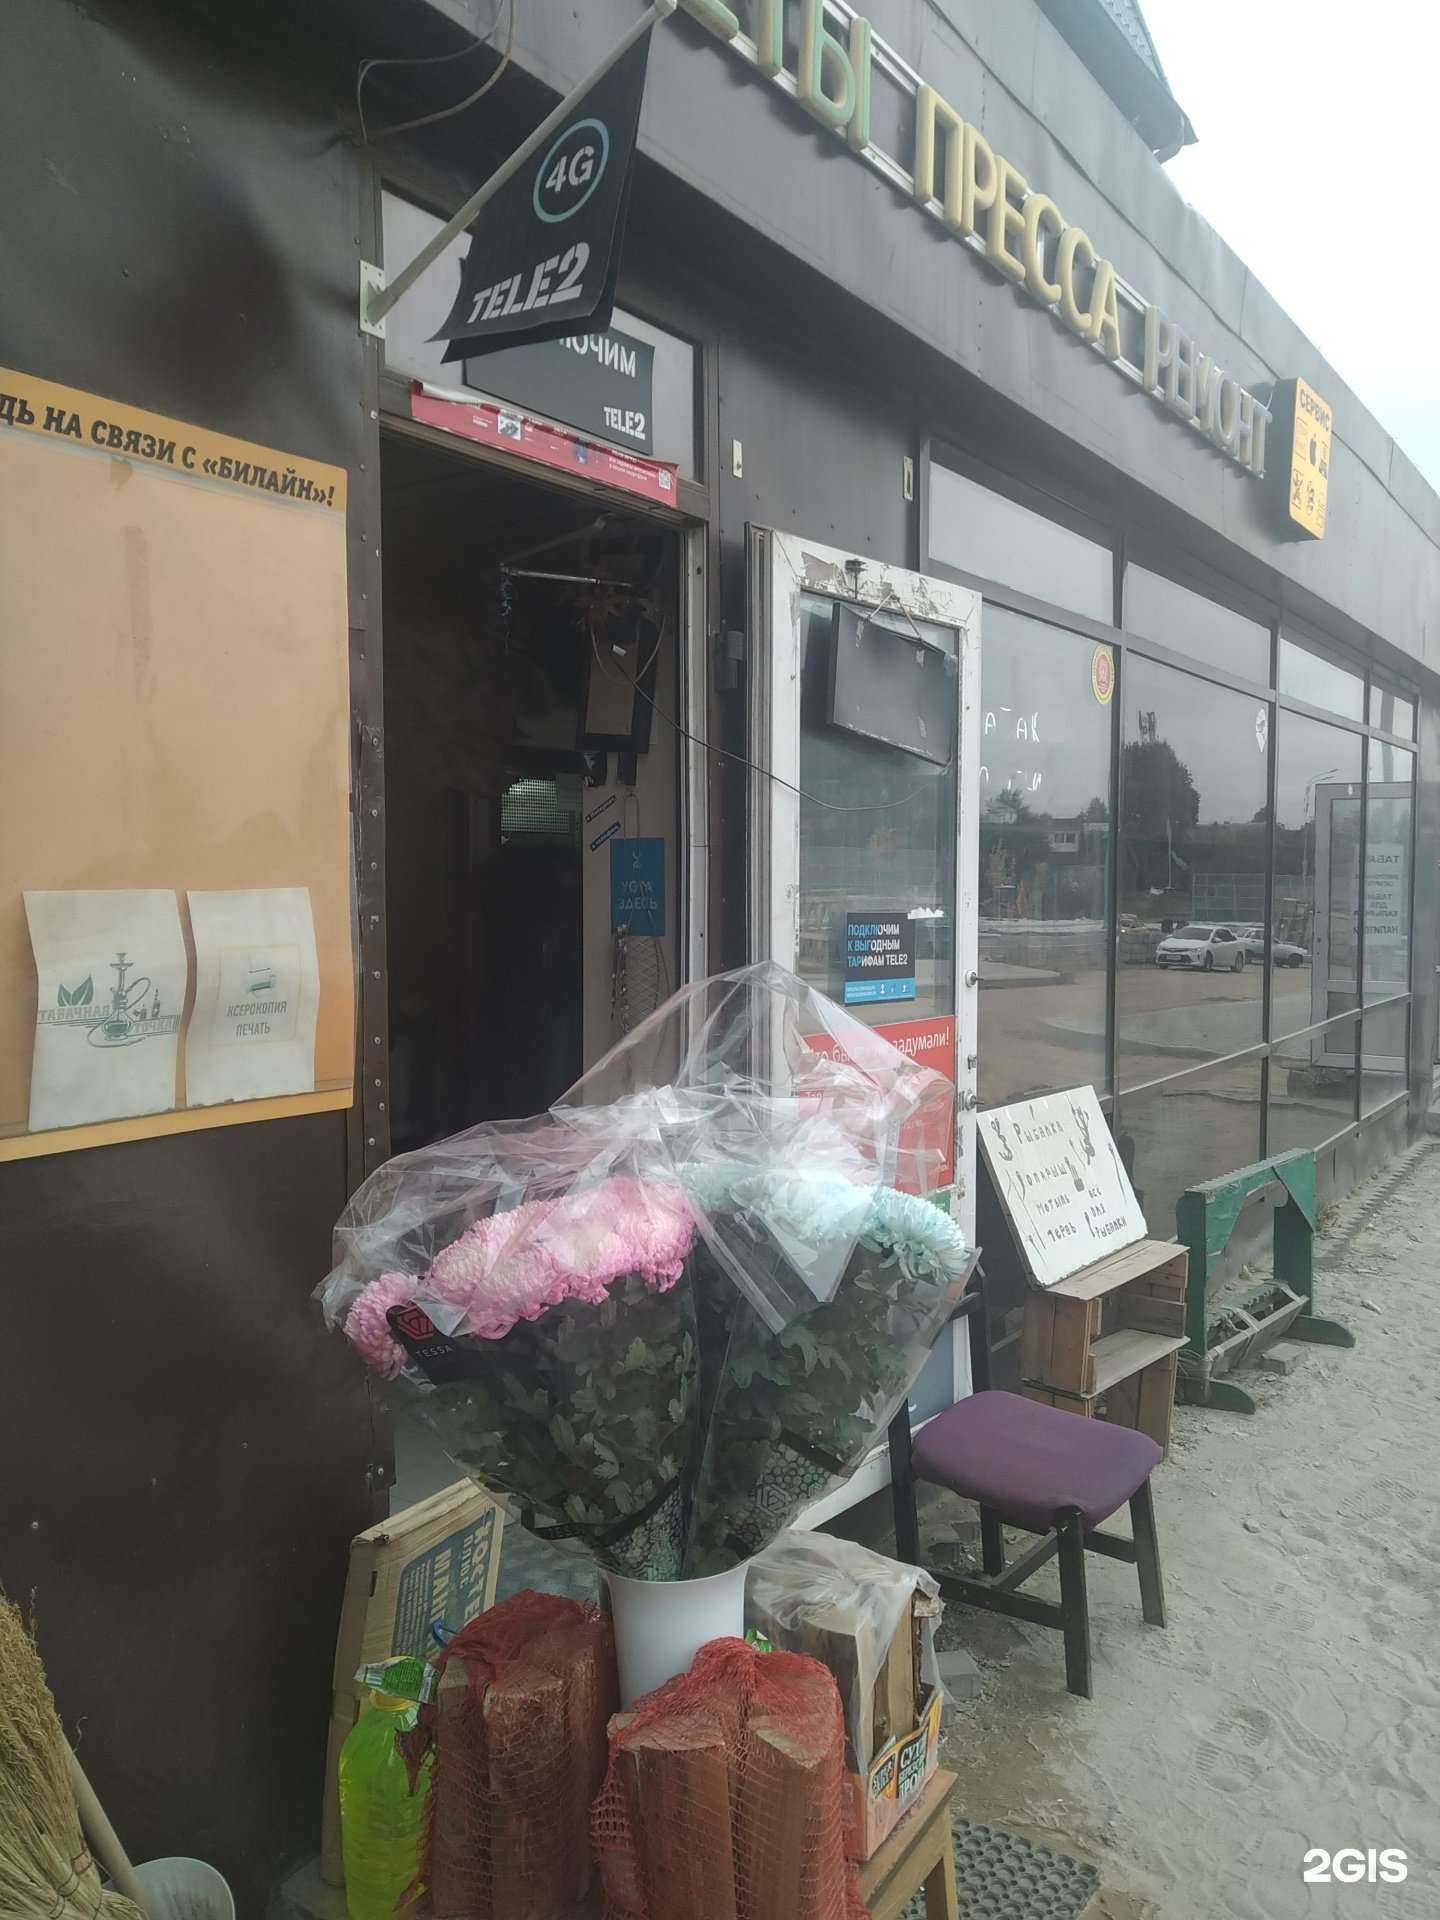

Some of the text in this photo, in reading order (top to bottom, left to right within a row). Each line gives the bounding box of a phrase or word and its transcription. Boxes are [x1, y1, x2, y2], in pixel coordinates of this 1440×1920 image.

[546, 145, 595, 193] 4G
[467, 241, 591, 324] TELE2
[914, 83, 1121, 359] ПРЕССА
[1142, 304, 1273, 476] РЕМОНТ
[604, 406, 646, 441] TELE2
[1300, 388, 1331, 434] СЕРВИС
[43, 405, 83, 439] НА
[91, 419, 177, 465] СВЯЗИ
[182, 446, 197, 470] С
[202, 455, 335, 507] «БИЛАЙН»!
[847, 923, 900, 938] ПОДКЛЮЧИМ
[854, 939, 901, 953] ВЫГОДНЫМ
[886, 953, 909, 966] TELE2
[226, 1000, 287, 1017] КСЕРОКОПИЯ
[236, 1022, 271, 1037] ПЕЧАТЬ
